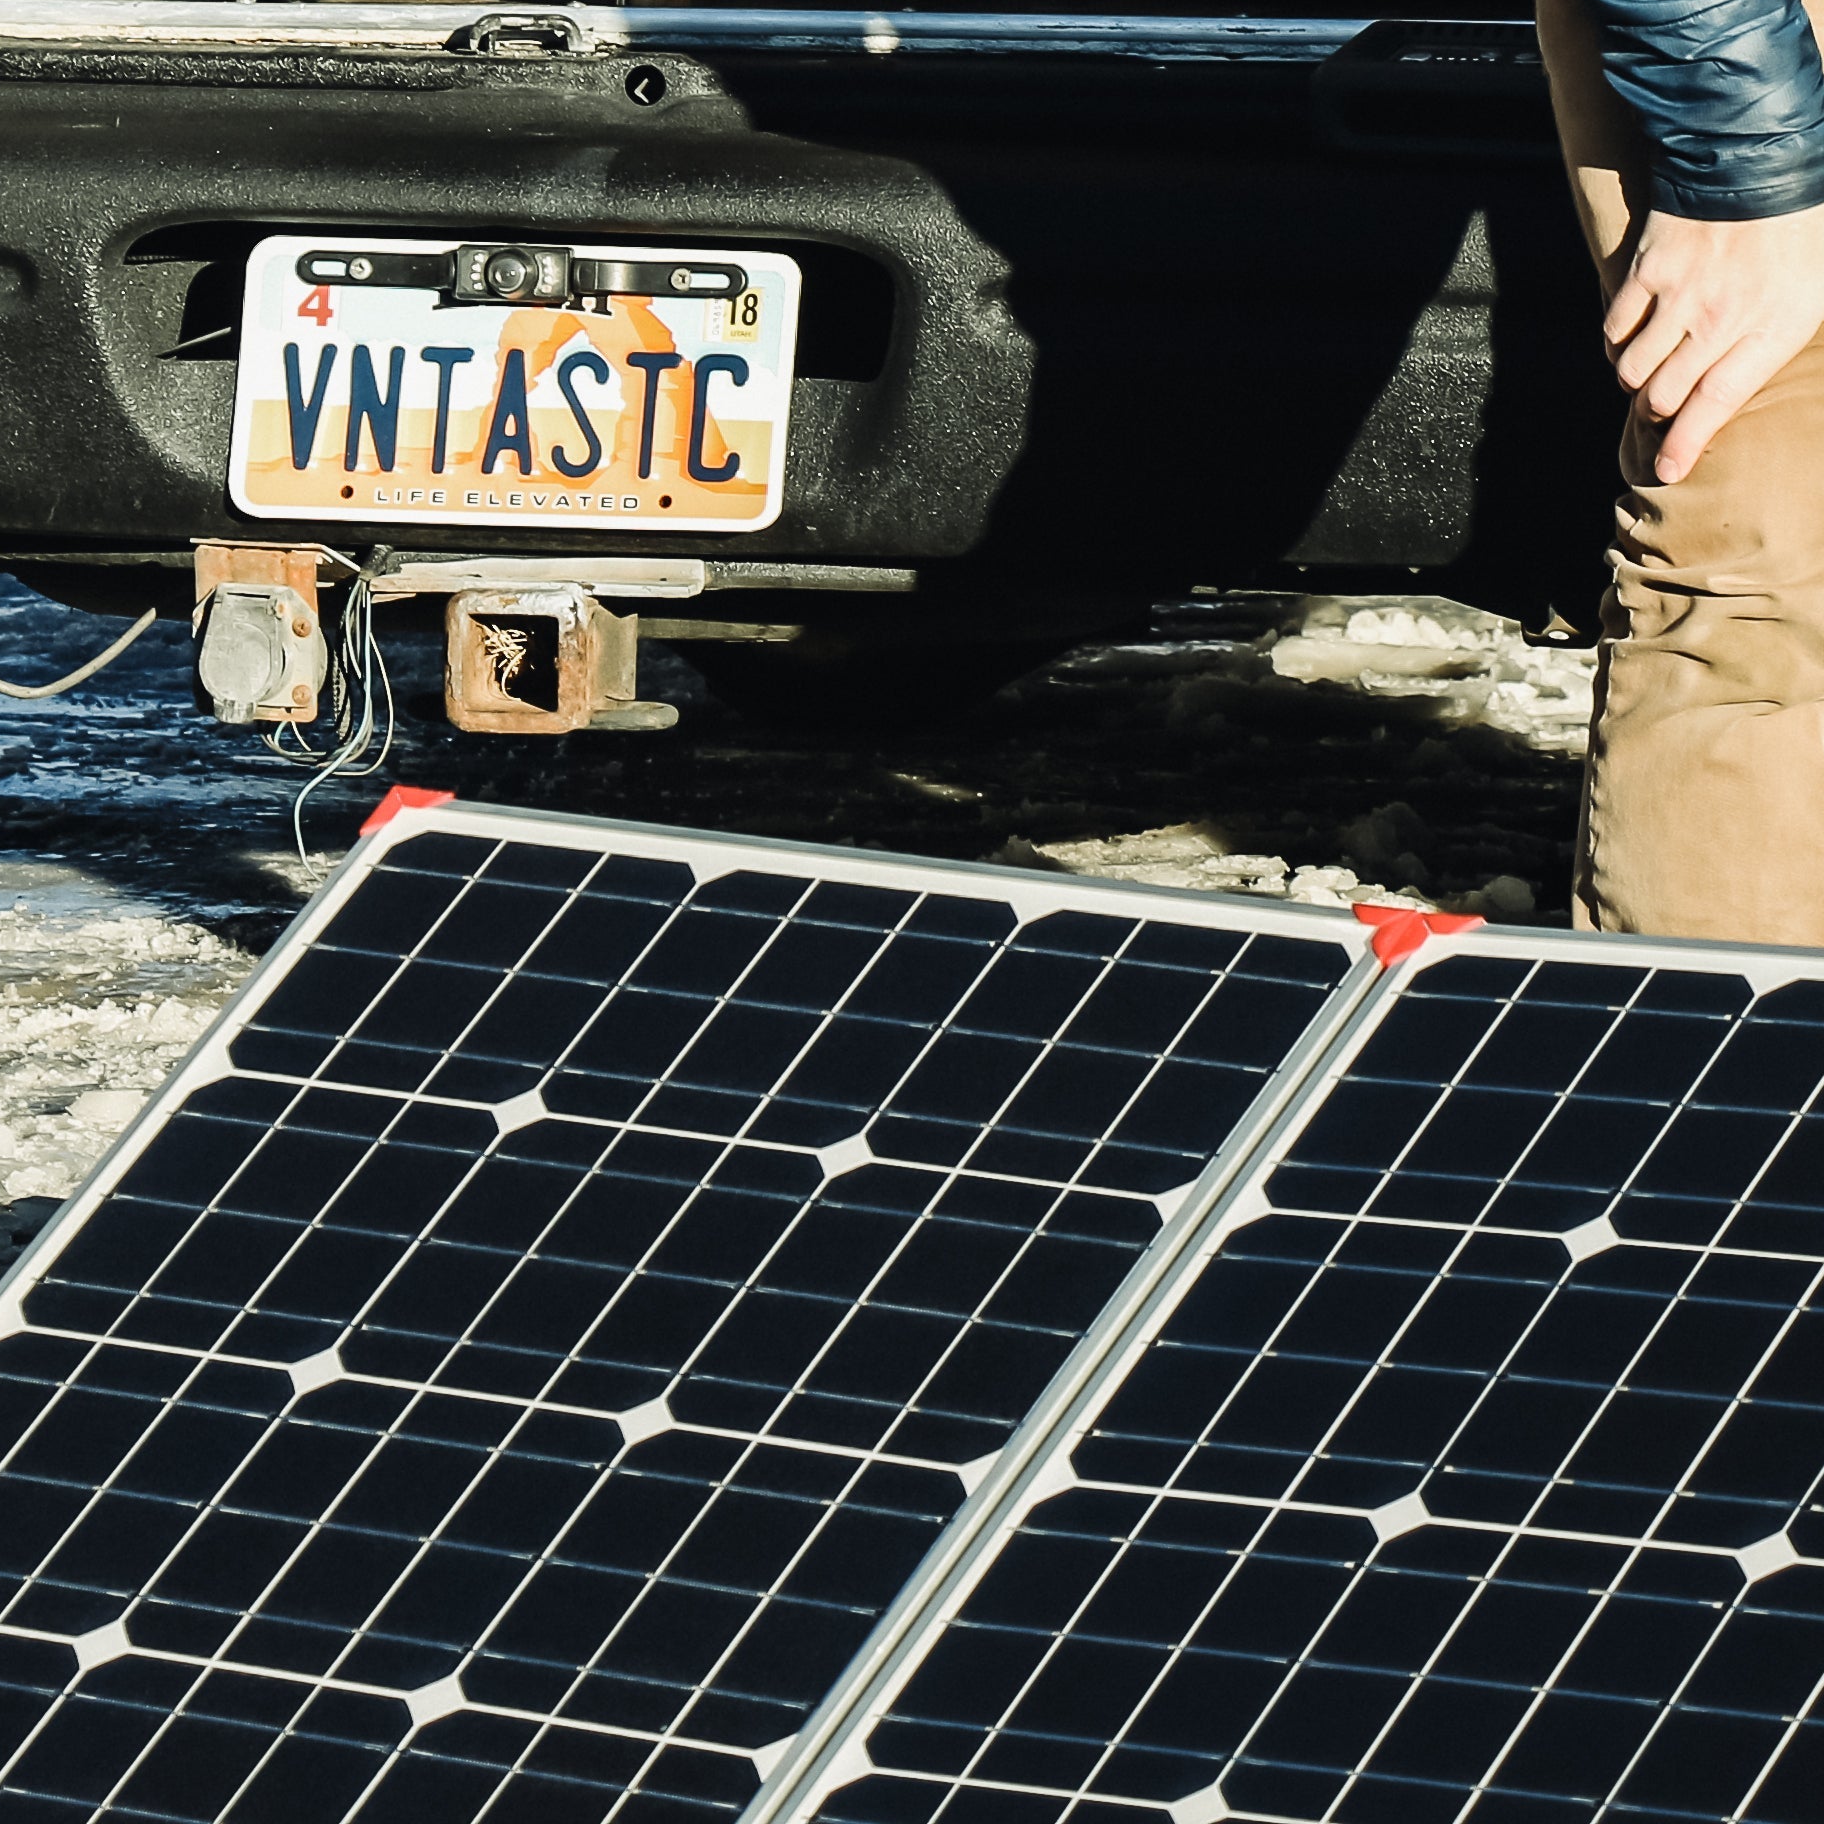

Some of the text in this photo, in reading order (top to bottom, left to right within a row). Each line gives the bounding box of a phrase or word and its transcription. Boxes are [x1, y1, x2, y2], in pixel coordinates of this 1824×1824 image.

[297, 284, 334, 326] 4
[727, 293, 759, 327] 18
[283, 341, 751, 483] VNTASTC
[376, 490, 639, 510] LIFE ELEVATED
